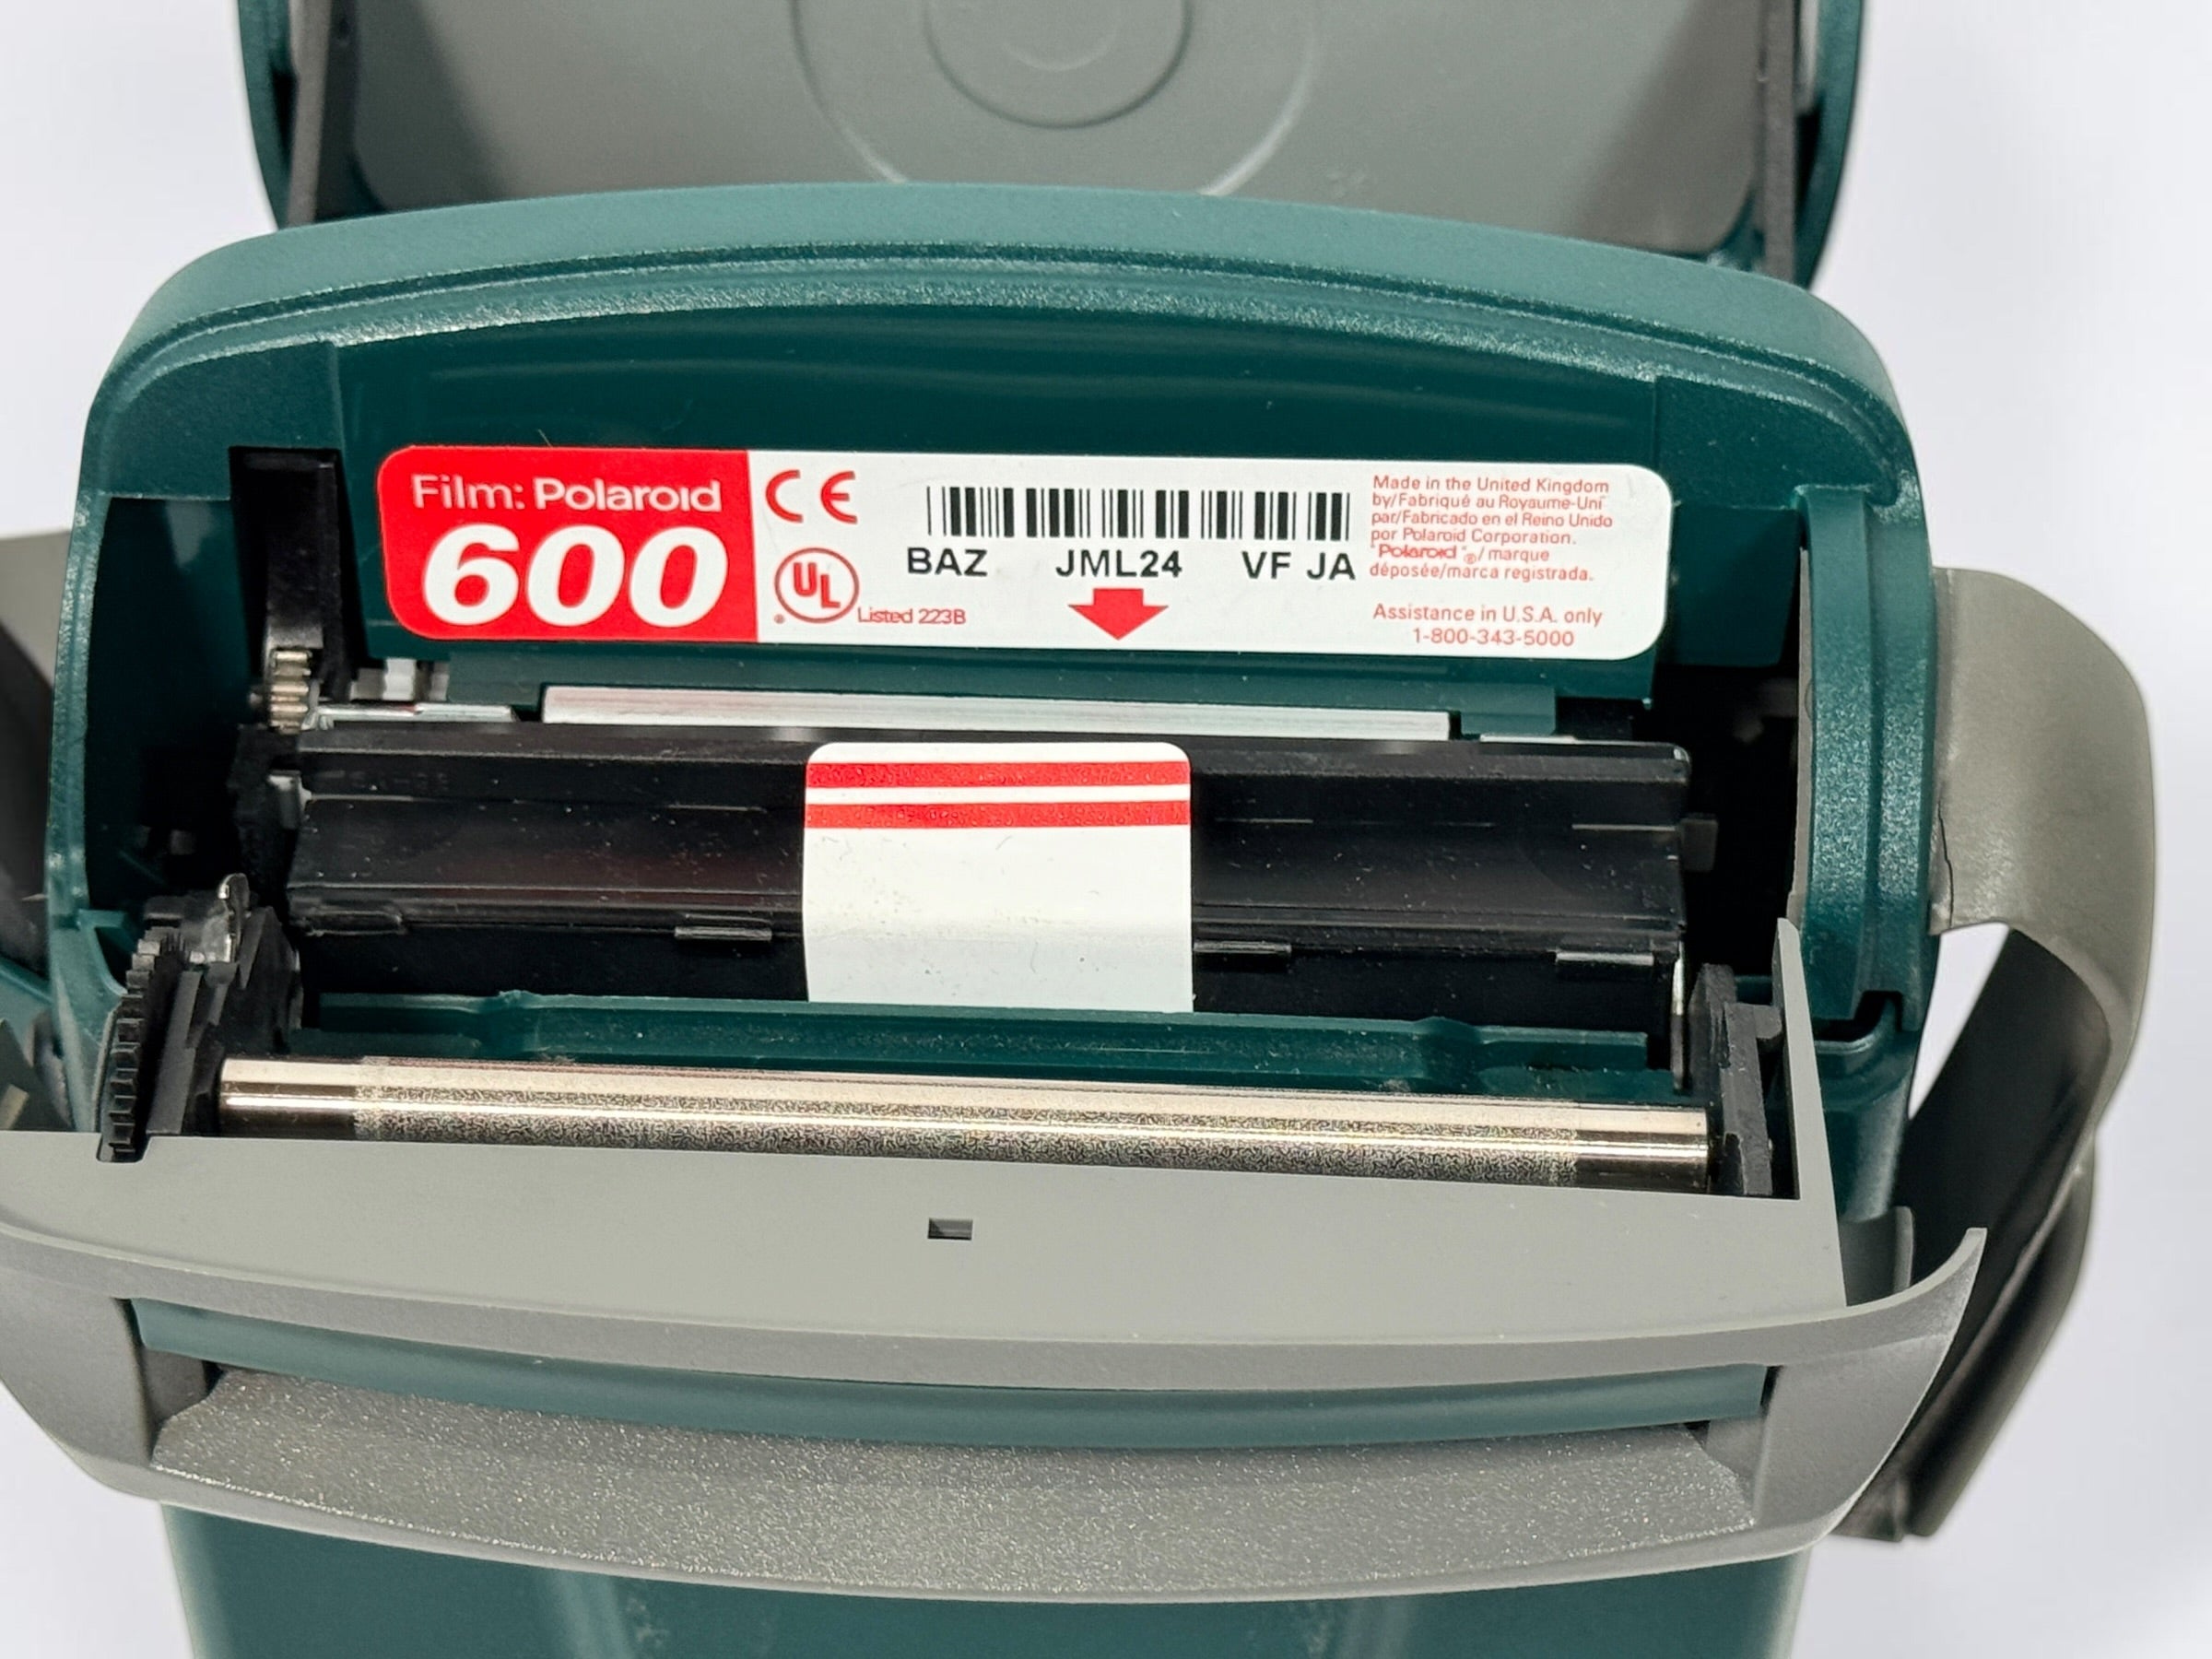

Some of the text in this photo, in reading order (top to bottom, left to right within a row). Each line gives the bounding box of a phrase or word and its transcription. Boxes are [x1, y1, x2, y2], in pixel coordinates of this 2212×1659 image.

[411, 473, 723, 512] Film: Polaroid
[1372, 475, 1609, 495] Made in the United Kingdom
[1371, 493, 1603, 512] by/Fabriqué au Royaume-Uni
[1371, 510, 1613, 528] par/Fabricado en el Reino Unido
[1371, 527, 1577, 546] por Polaroid Corporation.
[907, 547, 987, 577] BAZ
[1055, 549, 1182, 578] JML24
[1241, 551, 1291, 580] VF
[1306, 552, 1357, 581] JA
[1488, 547, 1550, 563] marque
[422, 523, 729, 628] 600
[1370, 561, 1594, 583] déposée/marca registrada.
[793, 561, 841, 608] UL
[857, 607, 966, 625] Listed 223B
[1372, 603, 1603, 628] Assistance in U.S.A. only
[1413, 627, 1575, 647] 1-800-343-5000
